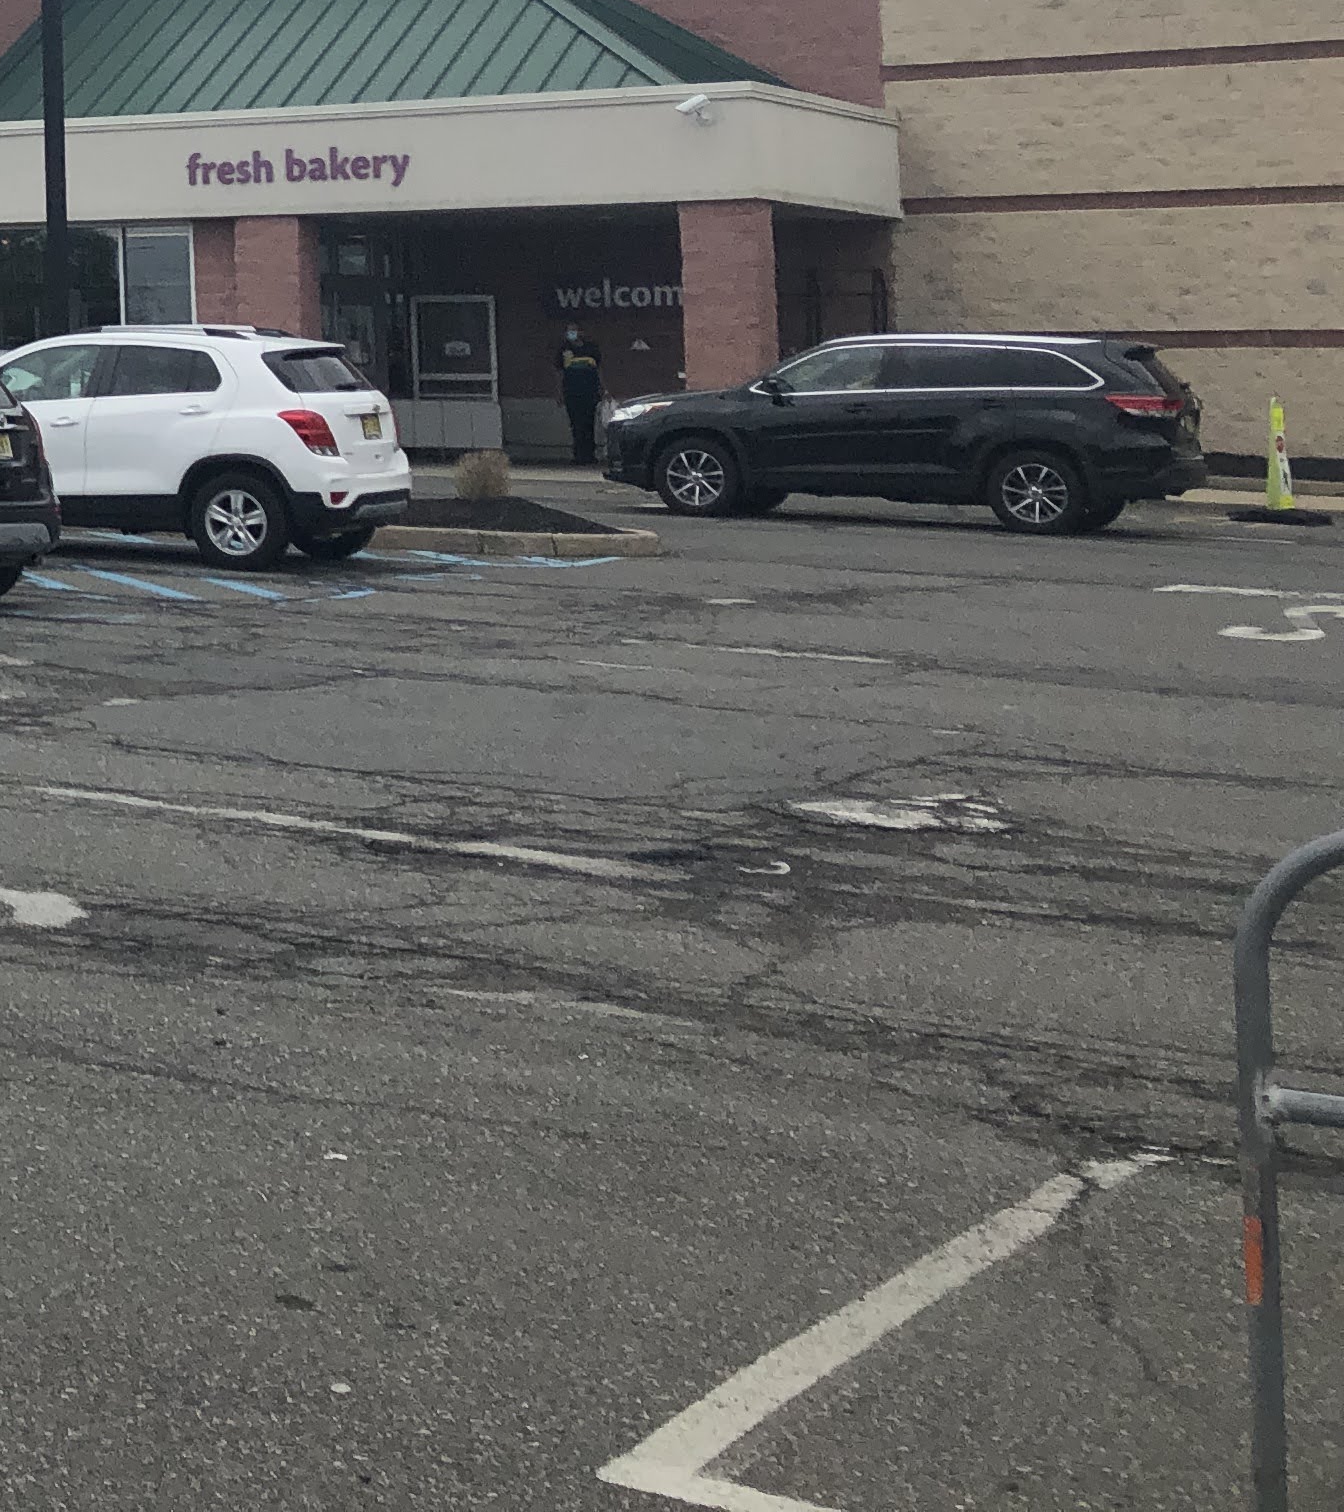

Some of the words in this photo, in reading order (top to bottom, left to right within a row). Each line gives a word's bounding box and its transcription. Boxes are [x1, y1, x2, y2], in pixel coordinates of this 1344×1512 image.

[186, 150, 274, 186] fresh
[285, 147, 410, 187] bakery
[555, 277, 683, 308] welcom
